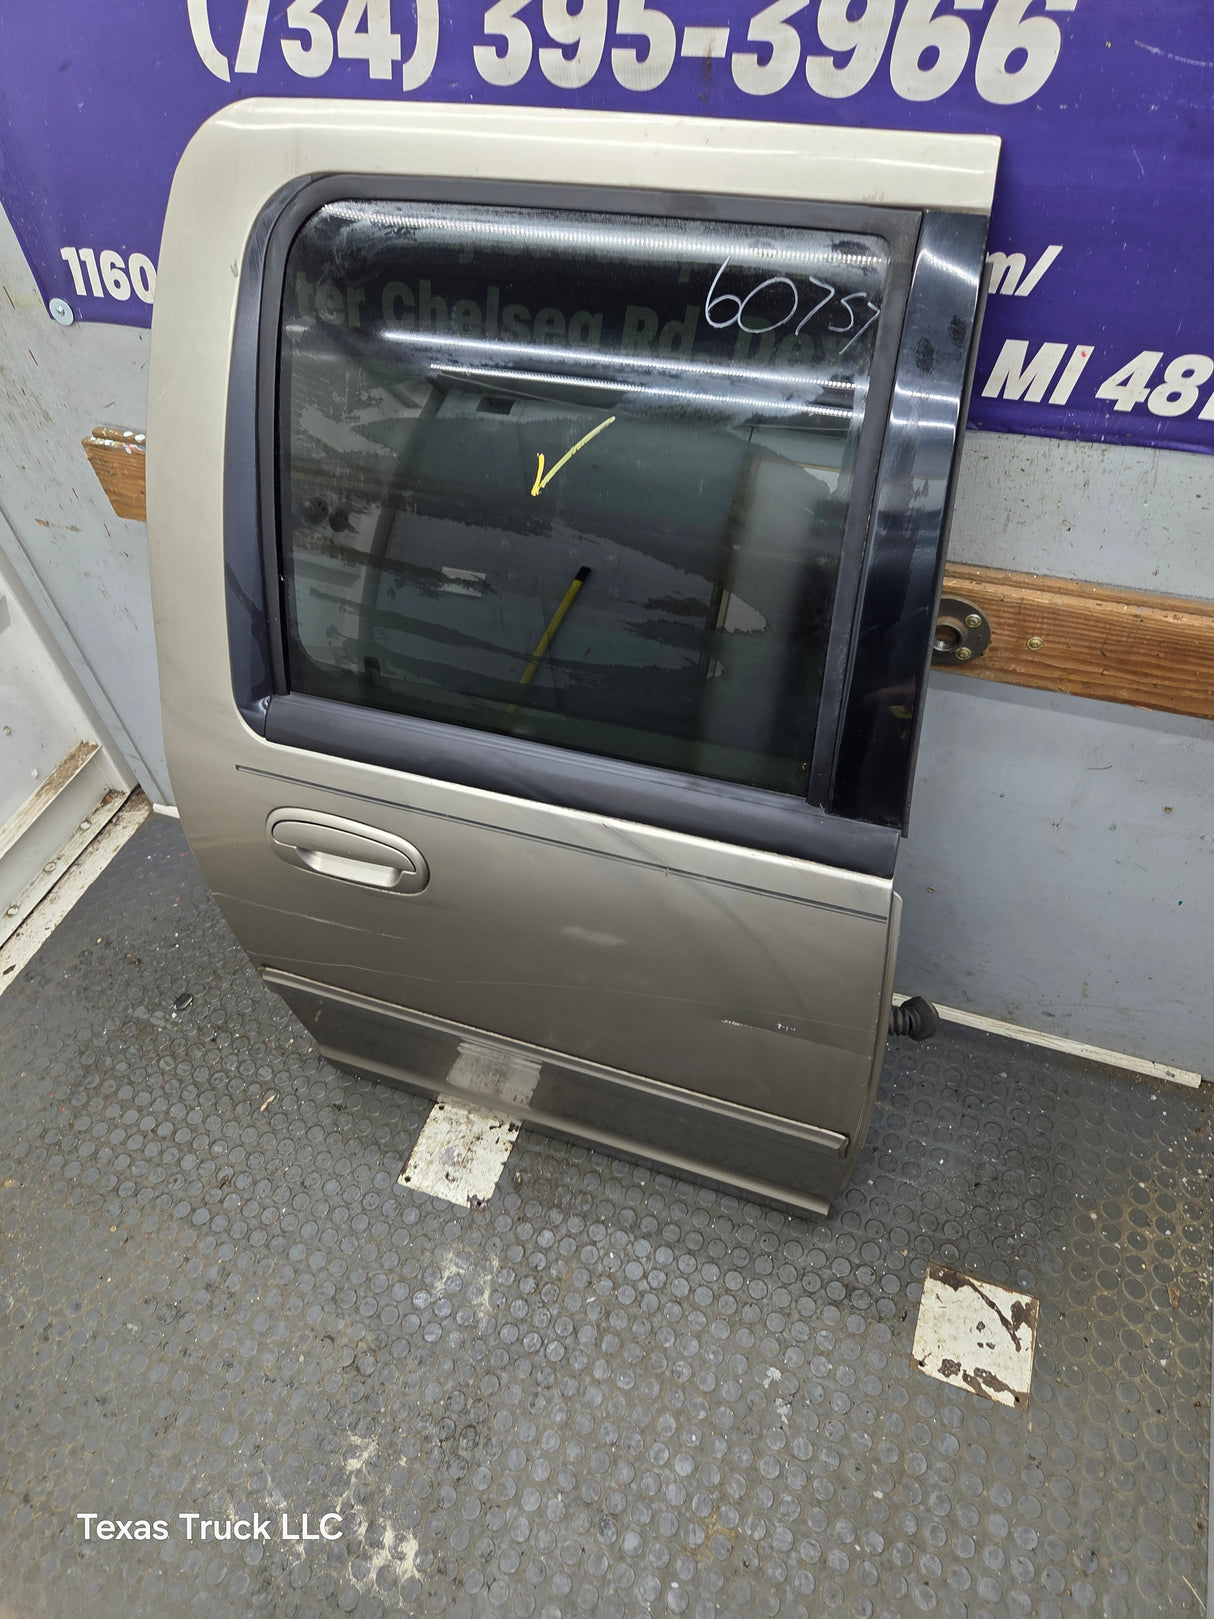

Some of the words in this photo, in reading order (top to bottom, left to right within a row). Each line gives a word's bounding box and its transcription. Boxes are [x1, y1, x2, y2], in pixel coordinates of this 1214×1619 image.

[187, 0, 440, 91] (734)
[473, 0, 1078, 105] 395-3966
[60, 246, 157, 305] 1160
[381, 279, 606, 347] Chelsea
[981, 339, 1095, 406] MI
[1095, 350, 1214, 421] 48
